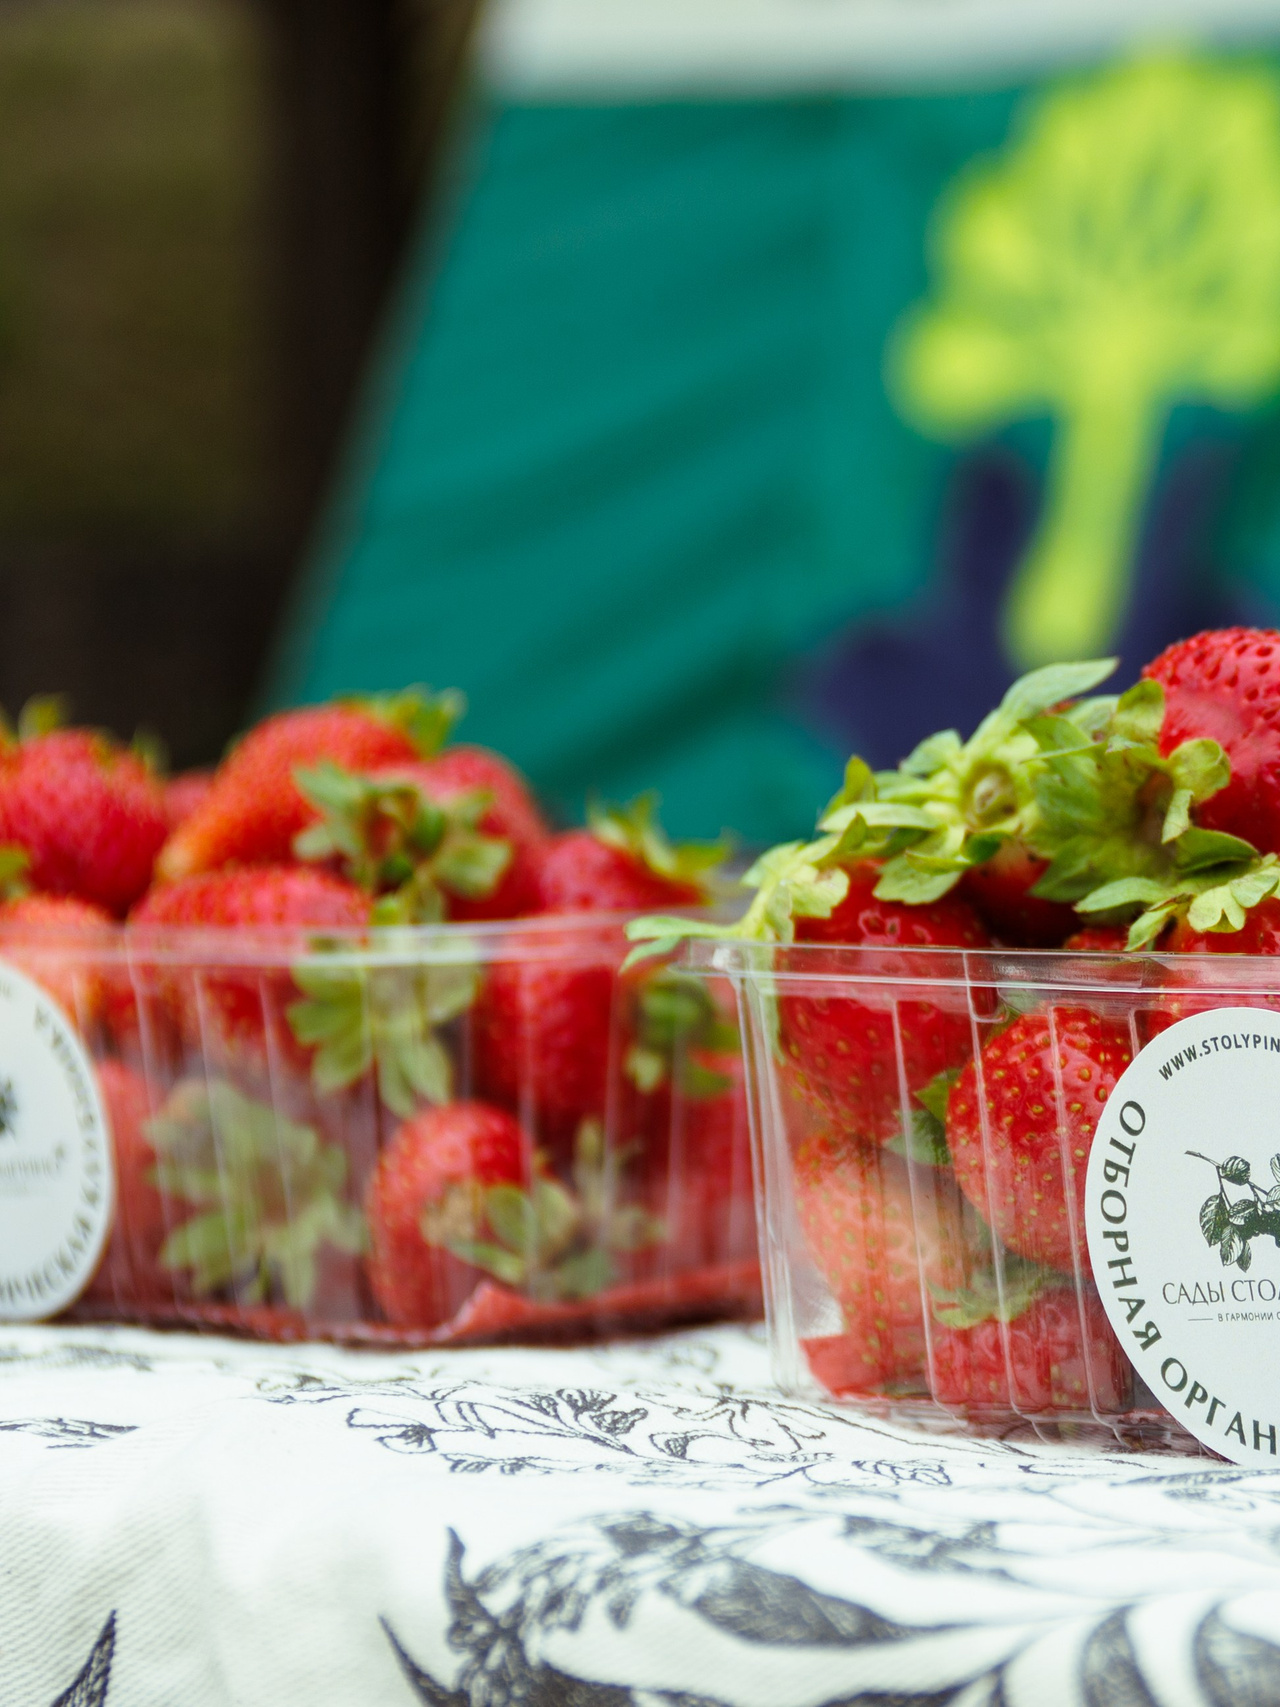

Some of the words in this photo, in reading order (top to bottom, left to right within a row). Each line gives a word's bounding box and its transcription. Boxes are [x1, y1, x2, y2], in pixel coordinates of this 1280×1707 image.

[1101, 1100, 1162, 1351] ОТБОРНАЯ
[1162, 1281, 1225, 1307] САДЫ
[1217, 1314, 1223, 1322] В
[1225, 1312, 1275, 1322] ГАРМОНИИ
